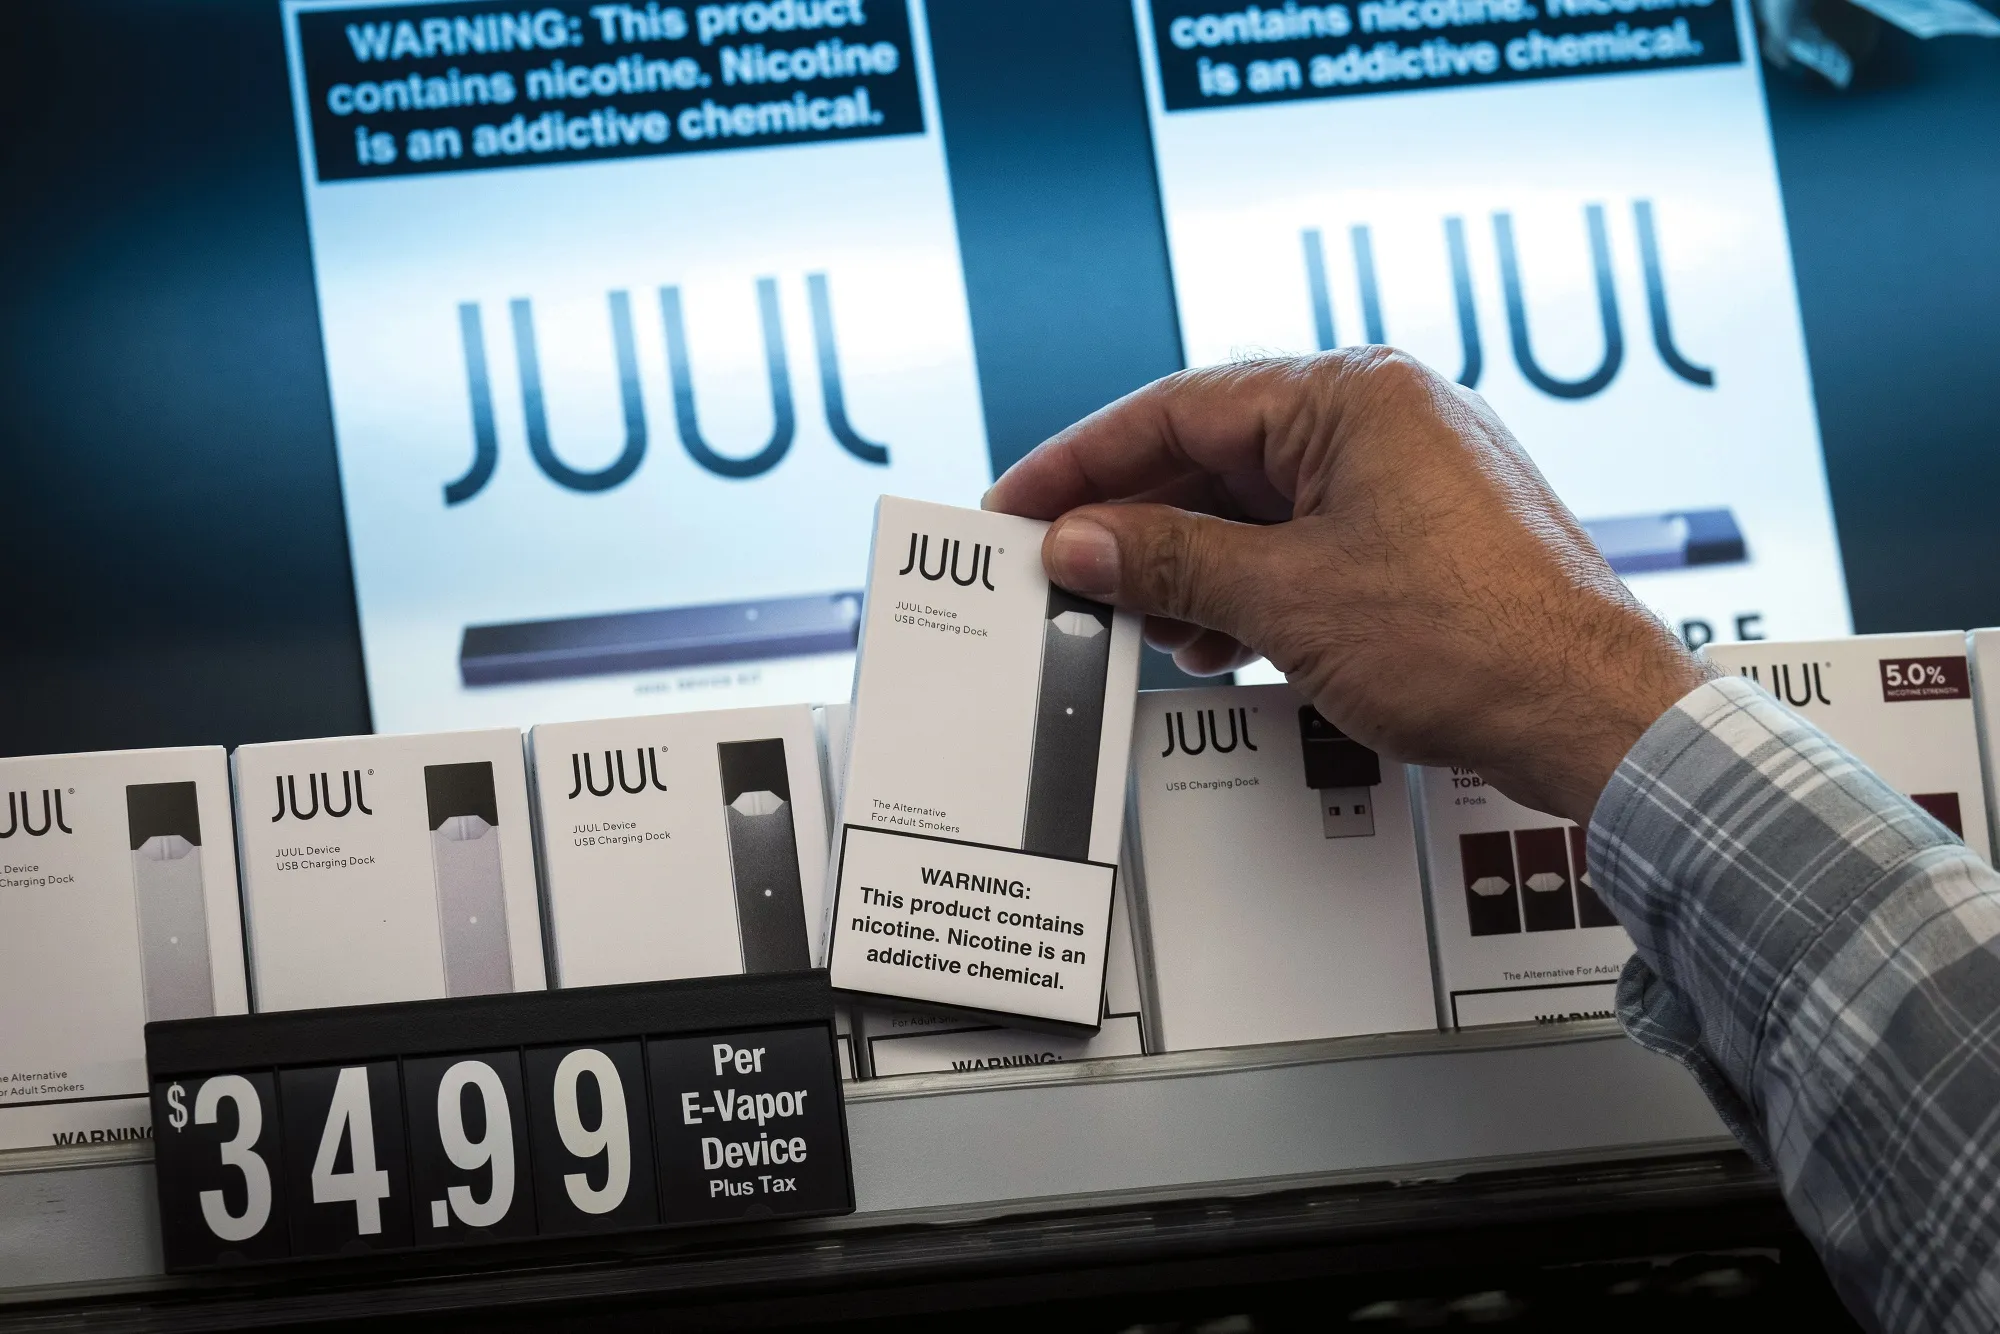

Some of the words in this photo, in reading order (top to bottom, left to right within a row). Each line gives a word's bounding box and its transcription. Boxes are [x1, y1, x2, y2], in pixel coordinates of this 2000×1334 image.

[345, 10, 584, 62] WARNING:
[590, 2, 688, 43] This
[697, 0, 866, 48] product
[1170, 0, 1352, 49] contains
[1197, 56, 1240, 97] is
[1246, 57, 1302, 93] an
[1309, 36, 1499, 88] addictive
[1505, 16, 1703, 71] chemical.
[327, 67, 517, 116] contains
[525, 50, 712, 101] nicotine.
[719, 40, 898, 85] Nicotine
[354, 126, 396, 166] is
[406, 123, 462, 161] an
[472, 106, 670, 156] addictive
[678, 86, 883, 140] chemical.
[443, 270, 890, 508] JUUL
[899, 533, 995, 591] JUUL
[895, 602, 922, 614] JUUL
[925, 605, 958, 619] Device
[894, 614, 915, 625] USB
[917, 617, 961, 634] Charging
[963, 623, 988, 638] Dock
[1886, 662, 1946, 687] 5.0%
[1887, 687, 1921, 697] NICOTINE
[1161, 707, 1258, 758] JUUL
[568, 747, 667, 799] JUUL
[1165, 782, 1186, 792] USB
[1188, 779, 1232, 792] Charging
[1235, 777, 1260, 788] Dock
[272, 770, 373, 823] JUUL
[873, 799, 891, 811] The
[893, 801, 947, 819] Alternative
[1463, 796, 1487, 805] Pods
[573, 823, 601, 834] JUUL
[603, 821, 637, 831] Device
[871, 812, 887, 823] For
[889, 814, 916, 828] Adult
[918, 818, 960, 834] Smokers
[276, 847, 304, 858] JUUL
[306, 844, 341, 855] Device
[574, 837, 596, 847] USB
[597, 833, 643, 846] Charging
[645, 830, 671, 841] Dock
[4, 864, 39, 874] Device
[276, 860, 298, 871] USB
[301, 857, 346, 871] Charging
[349, 855, 376, 866] Dock
[48, 874, 75, 884] Dock
[921, 866, 1031, 900] WARNING:
[860, 886, 904, 909] This
[910, 894, 991, 922] product
[997, 908, 1085, 936] contains
[851, 916, 940, 944] nicotine.
[947, 928, 1032, 956] Nicotine
[1038, 941, 1055, 960] is
[1061, 948, 1086, 965] an
[866, 946, 961, 974] addictive
[967, 959, 1064, 990] chemical.
[1503, 971, 1521, 981] The
[1523, 969, 1574, 979] Alternative
[1577, 966, 1592, 976] For
[1595, 964, 1620, 974] Adult
[713, 1045, 766, 1076] Per
[11, 1070, 68, 1082] Alternative
[10, 1085, 38, 1096] Adult
[41, 1083, 85, 1094] Smokers
[681, 1089, 809, 1129] E-Vapor
[702, 1135, 808, 1170] Device
[710, 1178, 754, 1198] Plus
[758, 1174, 797, 1194] Tax
